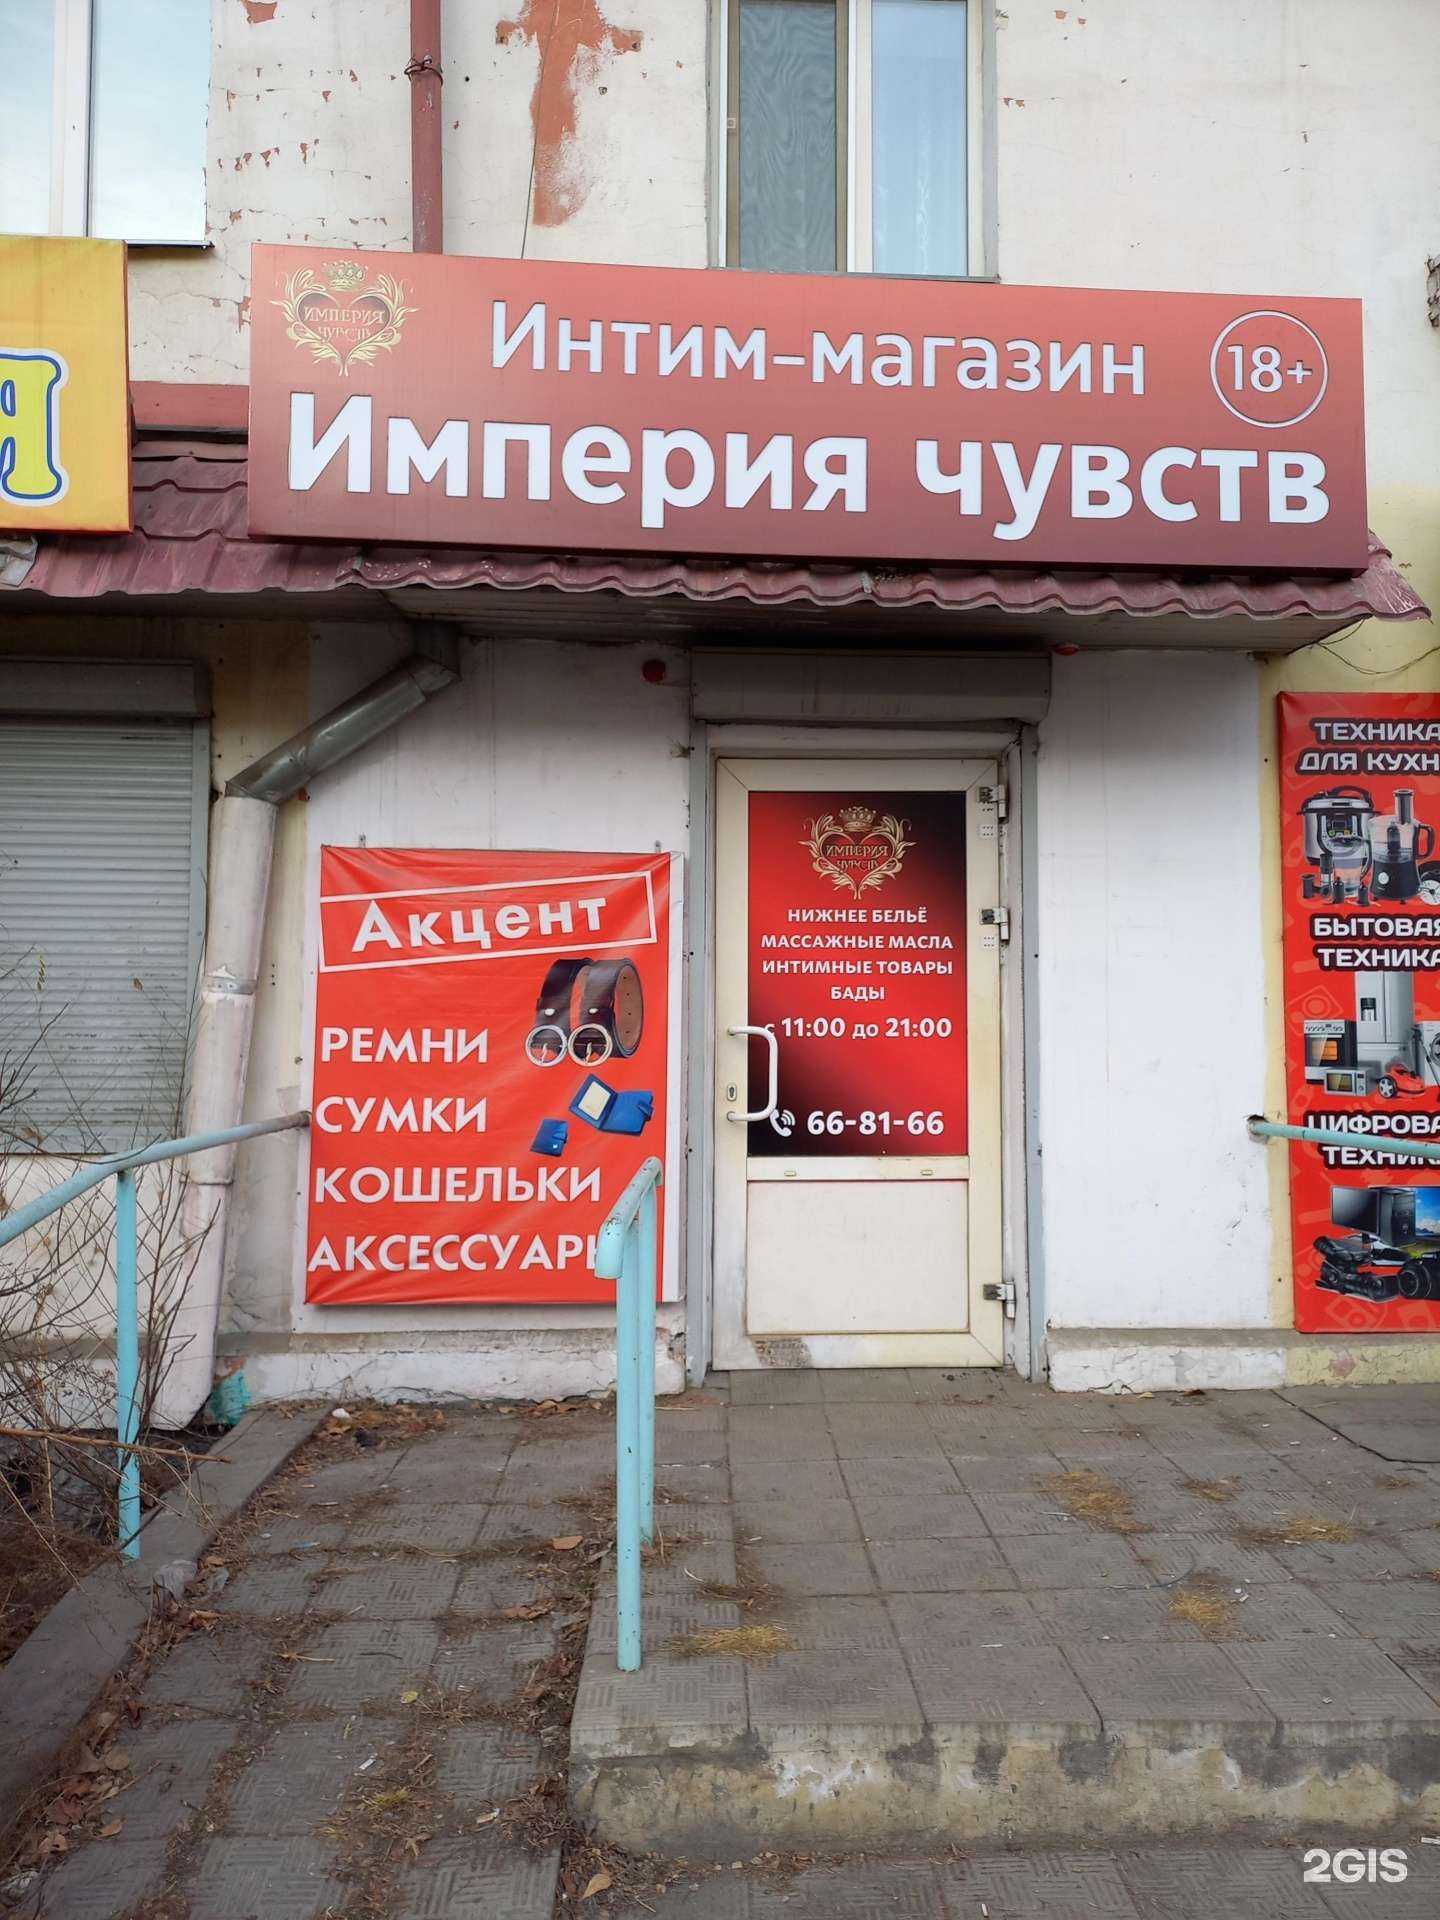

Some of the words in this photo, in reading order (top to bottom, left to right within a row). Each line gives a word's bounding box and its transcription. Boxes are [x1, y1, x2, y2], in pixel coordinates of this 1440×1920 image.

[303, 306, 385, 325] ИМПЕРИЯ
[492, 301, 1144, 396] Интим-магазин
[1226, 344, 1314, 393] 18+
[288, 391, 868, 529] Империя
[915, 437, 1331, 541] чувств
[1315, 722, 1440, 741] ТЕХНИКА
[1299, 752, 1358, 771] ДЛЯ
[351, 897, 607, 953] Акцент
[787, 909, 868, 924] НИЖНЕЕ
[872, 906, 928, 924] БЕЛЬЁ
[761, 934, 885, 950] МАССАЖНЫЕ
[888, 935, 954, 949] МАСЛА
[762, 960, 873, 974] ИНТИМНЫЕ
[875, 960, 953, 975] ТОВАРЫ
[831, 986, 885, 1002] БАДЫ
[781, 1017, 846, 1038] 11:00
[852, 1023, 879, 1040] до
[885, 1017, 952, 1038] 21:00
[321, 1027, 489, 1063] РЕМНИ
[314, 1096, 487, 1133] СУМКИ
[807, 1110, 944, 1135] 66-81-66
[315, 1166, 601, 1204] КОШЕЛЬКИ
